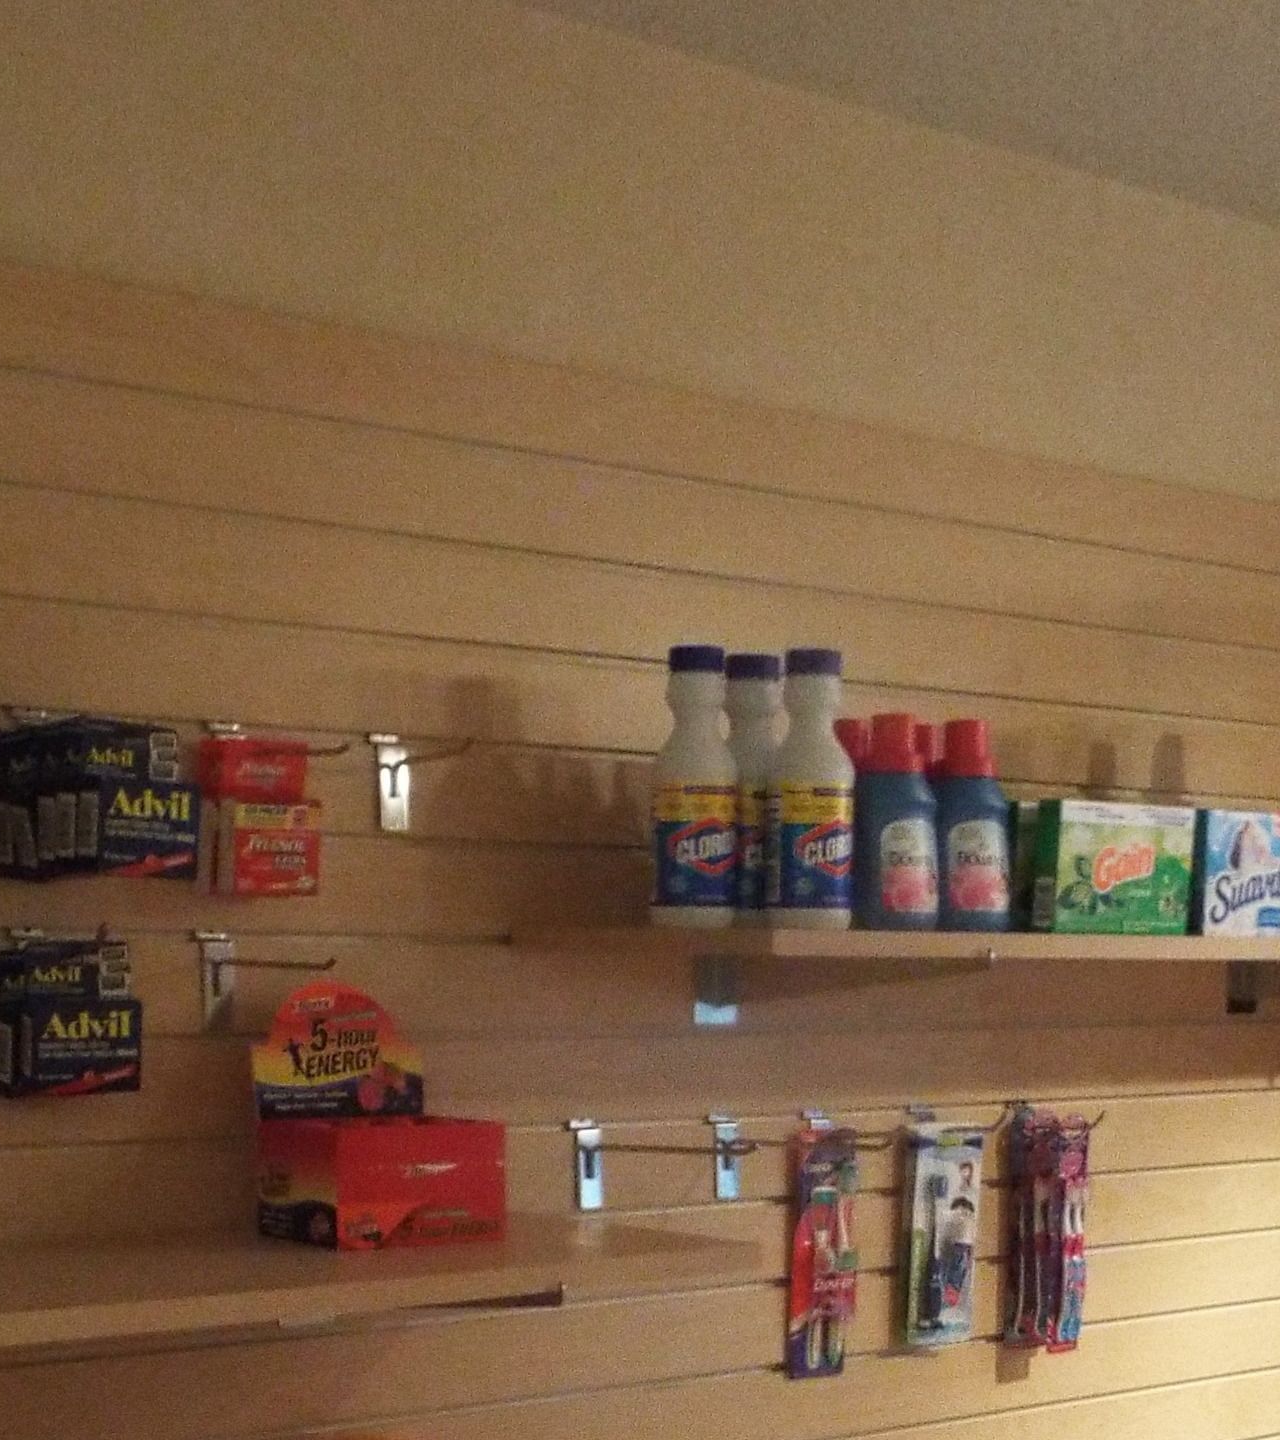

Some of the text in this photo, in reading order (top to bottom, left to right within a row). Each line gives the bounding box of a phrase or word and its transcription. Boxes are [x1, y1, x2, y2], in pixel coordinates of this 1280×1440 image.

[86, 746, 135, 768] Advil
[108, 787, 191, 821] Advil
[30, 964, 82, 984] Advil
[41, 1009, 133, 1039] Advil
[305, 1046, 380, 1079] ENERGY
